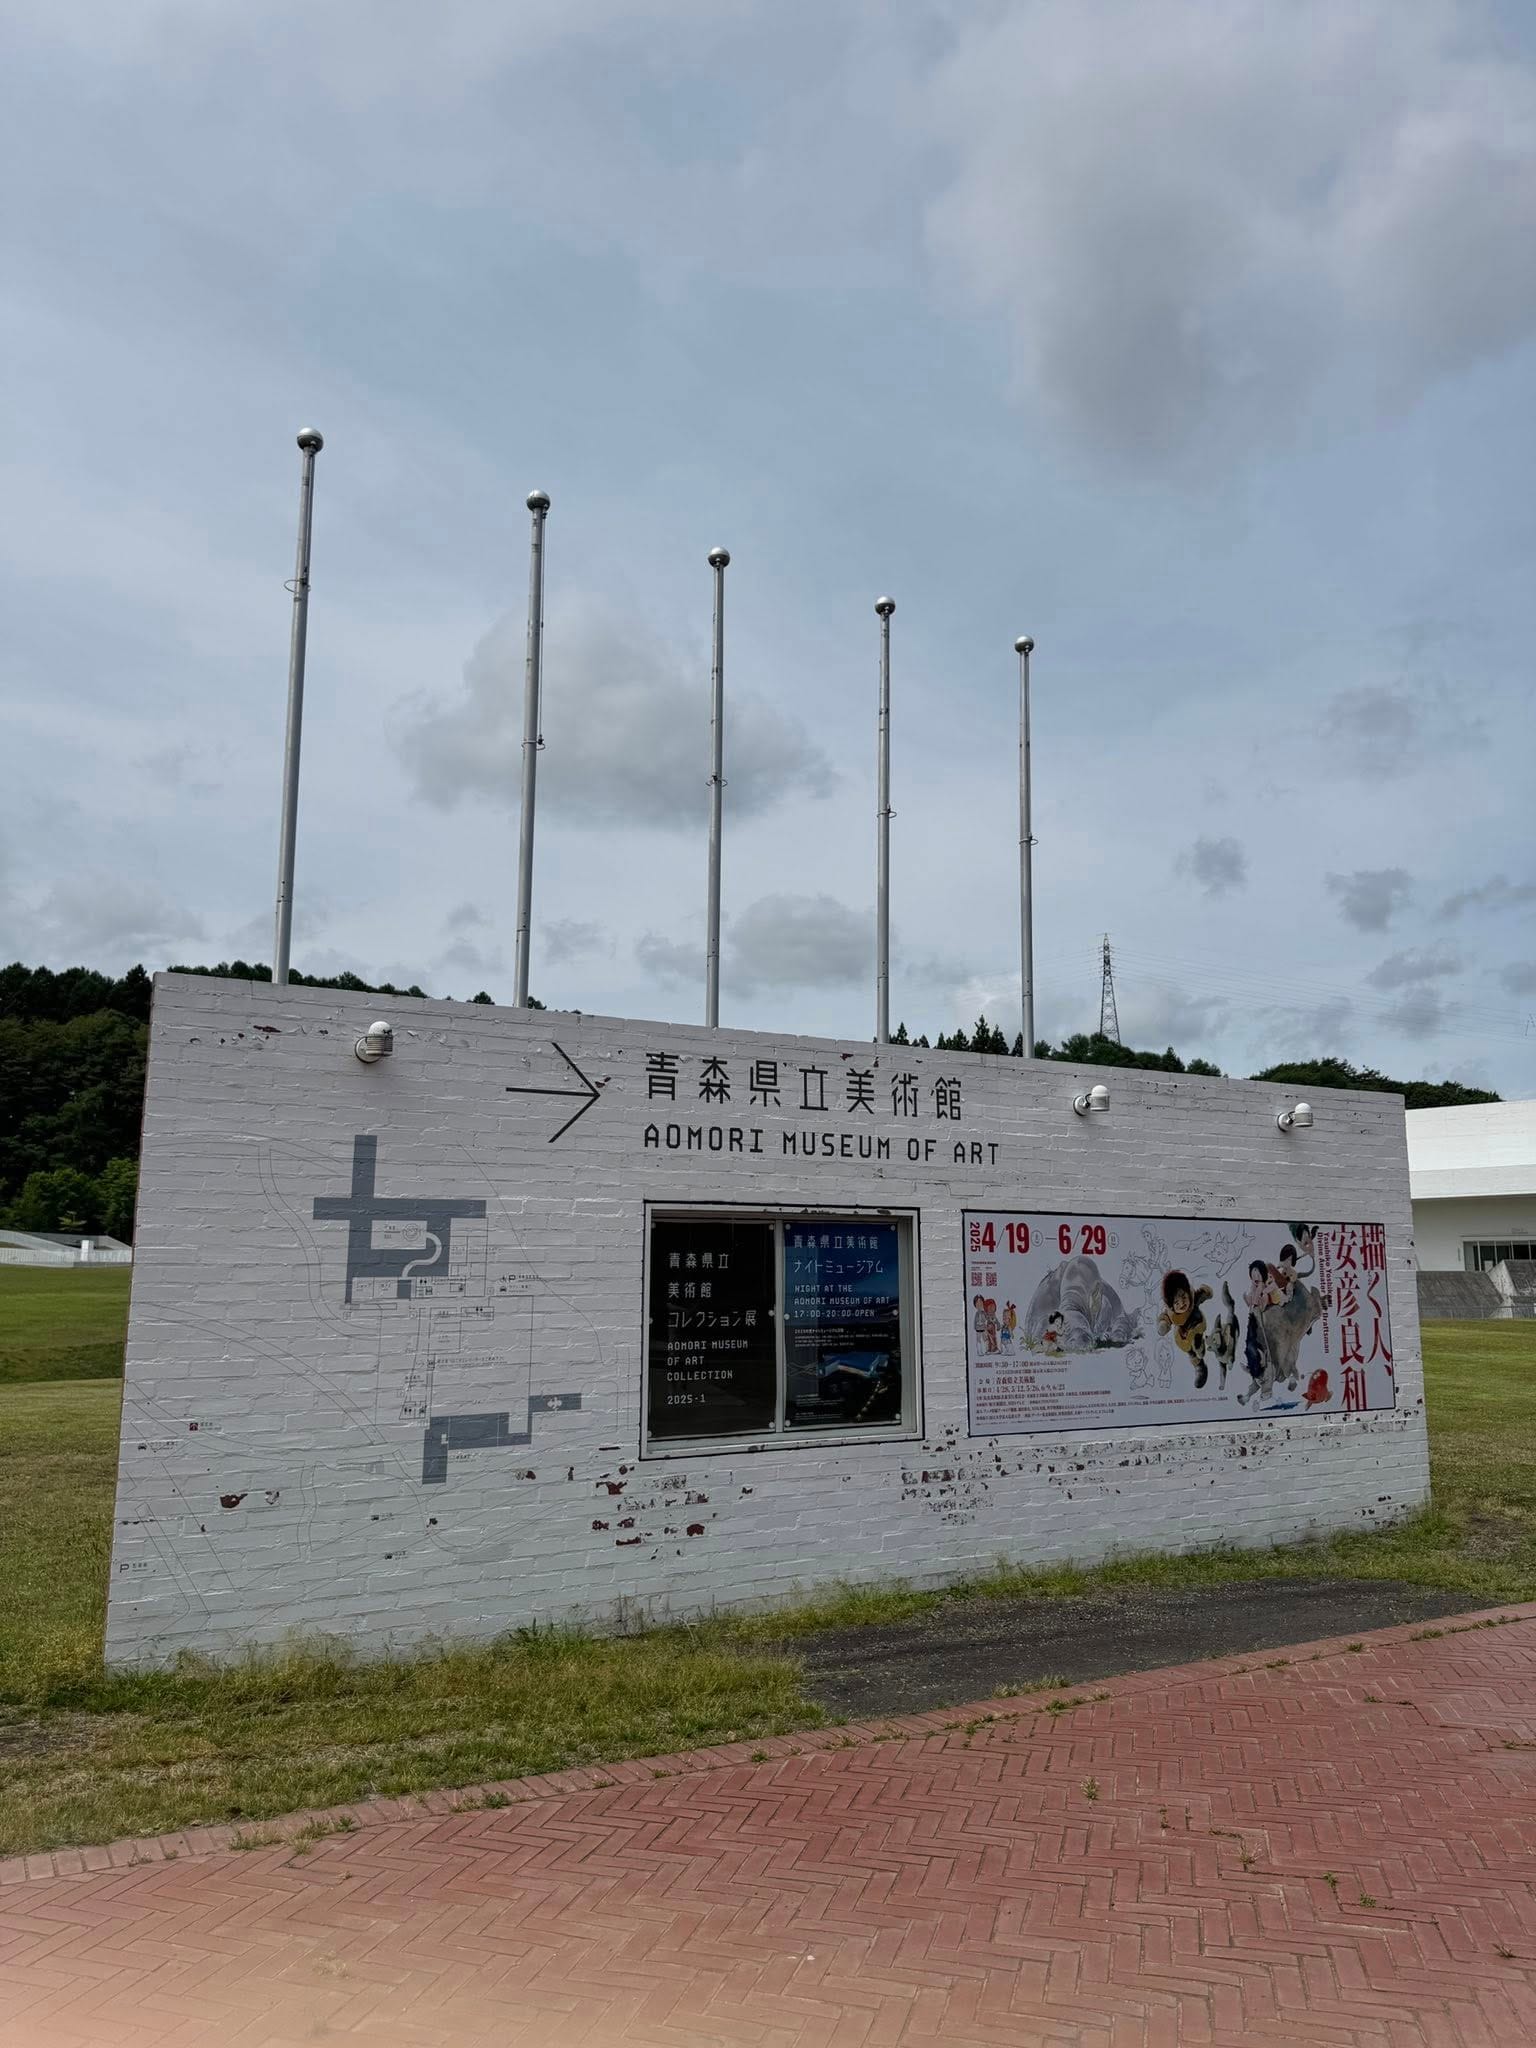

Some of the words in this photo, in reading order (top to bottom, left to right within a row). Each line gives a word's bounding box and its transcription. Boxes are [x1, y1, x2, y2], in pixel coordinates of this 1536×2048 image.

[645, 1052, 962, 1121] 青森県立美術館
[644, 1123, 764, 1153] AOMORI
[783, 1130, 890, 1160] MUSEUM
[907, 1137, 937, 1162] OF
[953, 1141, 999, 1165] ART
[794, 1234, 879, 1250] 青森県立美術館
[969, 1222, 981, 1253] 2025
[982, 1222, 1030, 1254] 4/19
[1059, 1223, 1107, 1255] 6/29
[1323, 1232, 1331, 1267] Yasuhiko
[669, 1252, 729, 1269] 青森県立
[794, 1259, 883, 1274] ナイトミュージアム
[668, 1282, 712, 1298] 美術館
[794, 1284, 820, 1293] NIGHT
[824, 1284, 834, 1293] AT
[838, 1284, 853, 1293] THE
[794, 1296, 826, 1305] AOMORI
[829, 1296, 860, 1305] MUSEUM
[863, 1296, 872, 1304] OF
[875, 1296, 890, 1304] ART
[667, 1310, 757, 1328] コレクション展
[854, 1309, 875, 1317] OPEN
[1331, 1224, 1367, 1411] 安彦良和
[667, 1340, 707, 1351] AOMORI
[711, 1339, 748, 1349] MUSEUM
[667, 1356, 680, 1366] OF
[685, 1355, 705, 1366] ART
[667, 1370, 733, 1381] COLLECTION
